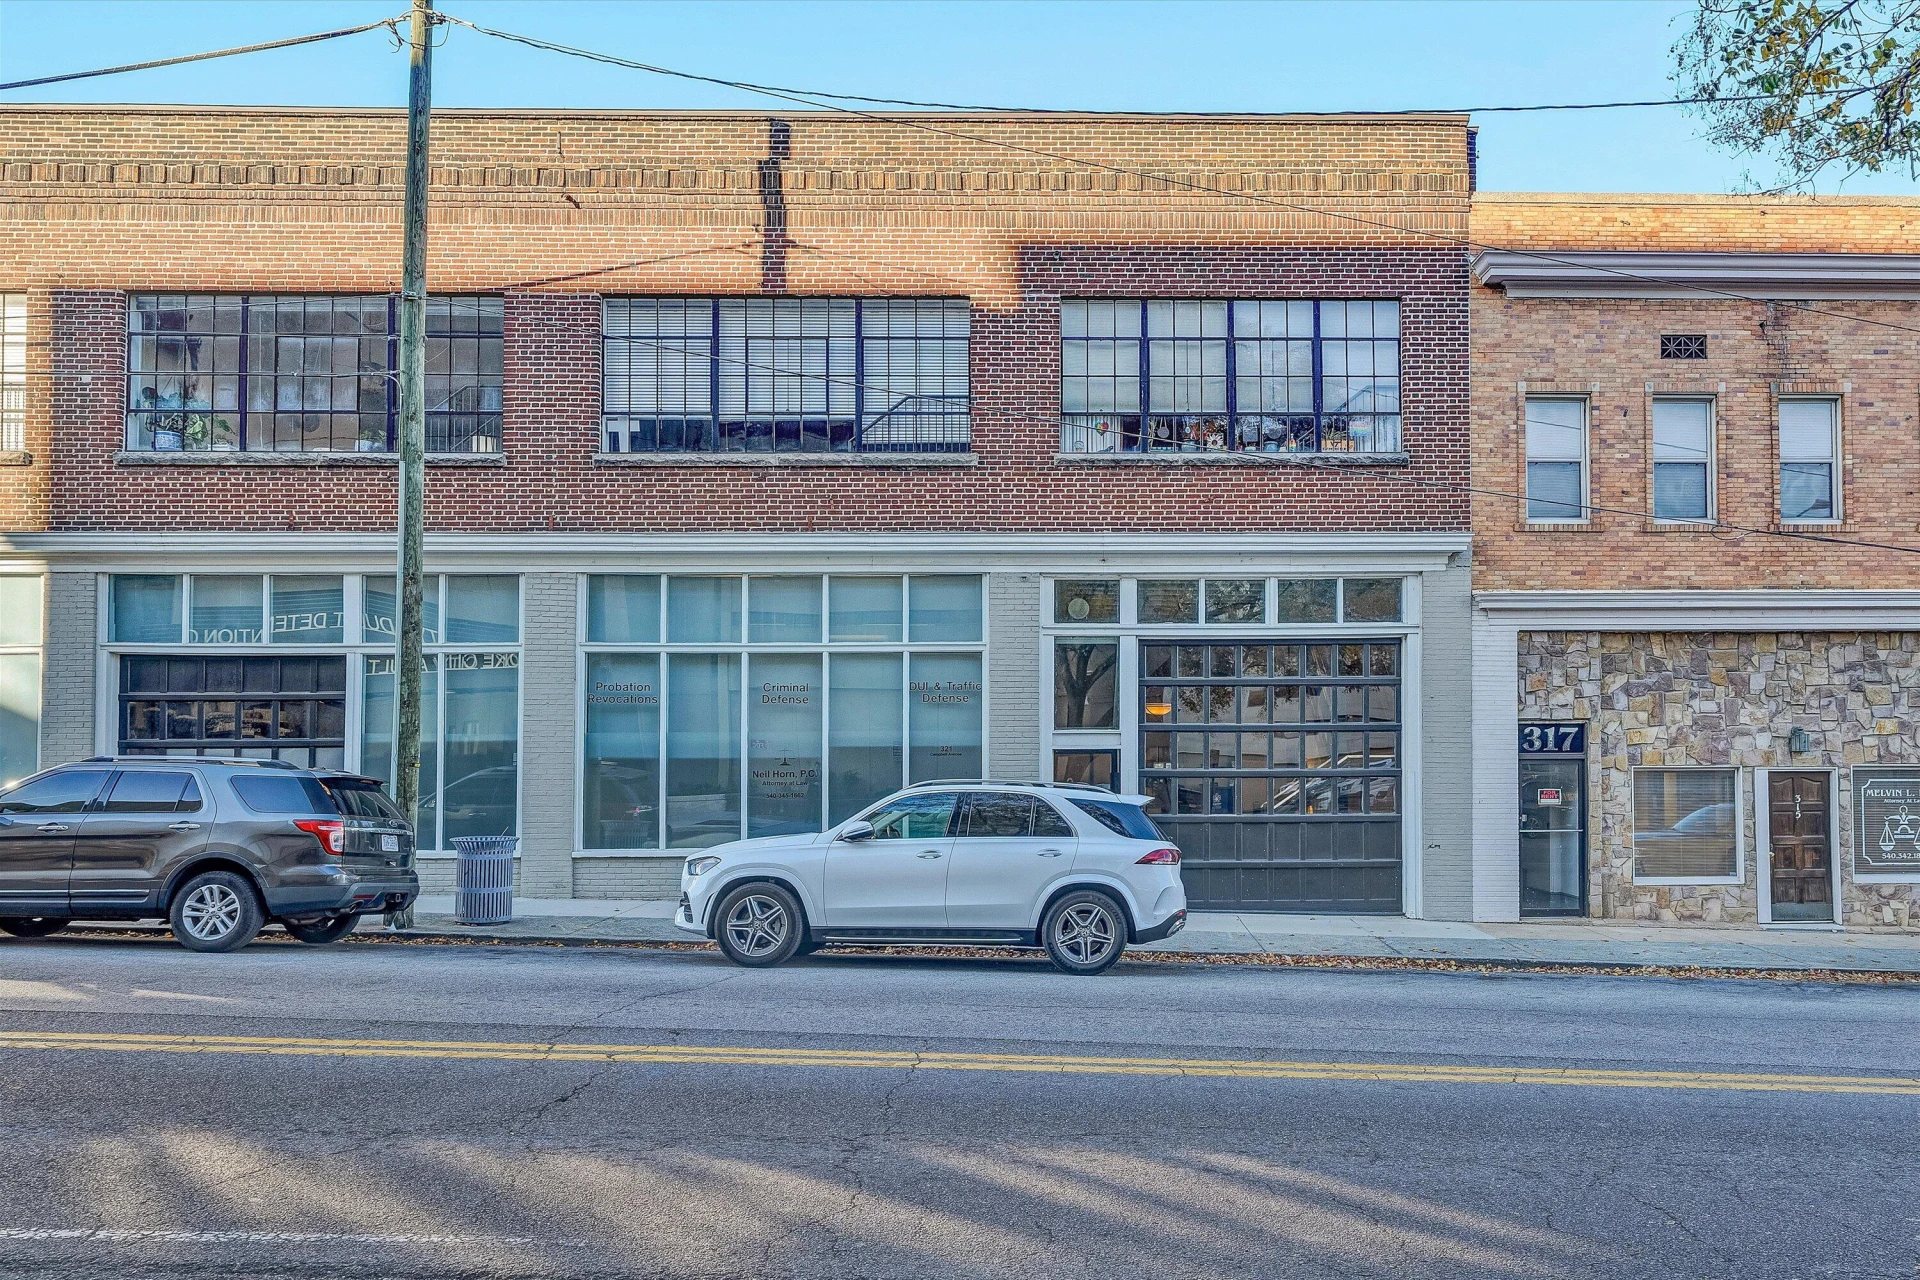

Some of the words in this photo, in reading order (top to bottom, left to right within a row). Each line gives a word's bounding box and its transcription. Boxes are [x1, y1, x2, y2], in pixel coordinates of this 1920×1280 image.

[595, 681, 651, 692] Probation
[763, 682, 809, 692] Criminal
[909, 681, 928, 691] DUI
[933, 681, 941, 691] &
[947, 681, 982, 691] Traffic
[588, 693, 658, 704] Revocations
[762, 694, 809, 704] Defense
[922, 693, 969, 703] Defense
[1521, 726, 1579, 751] 317
[752, 770, 770, 778] Neil
[772, 770, 798, 779] Horn,
[800, 769, 818, 778] P.C.
[1866, 789, 1902, 797] MELVIN
[1906, 789, 1915, 797] L.
